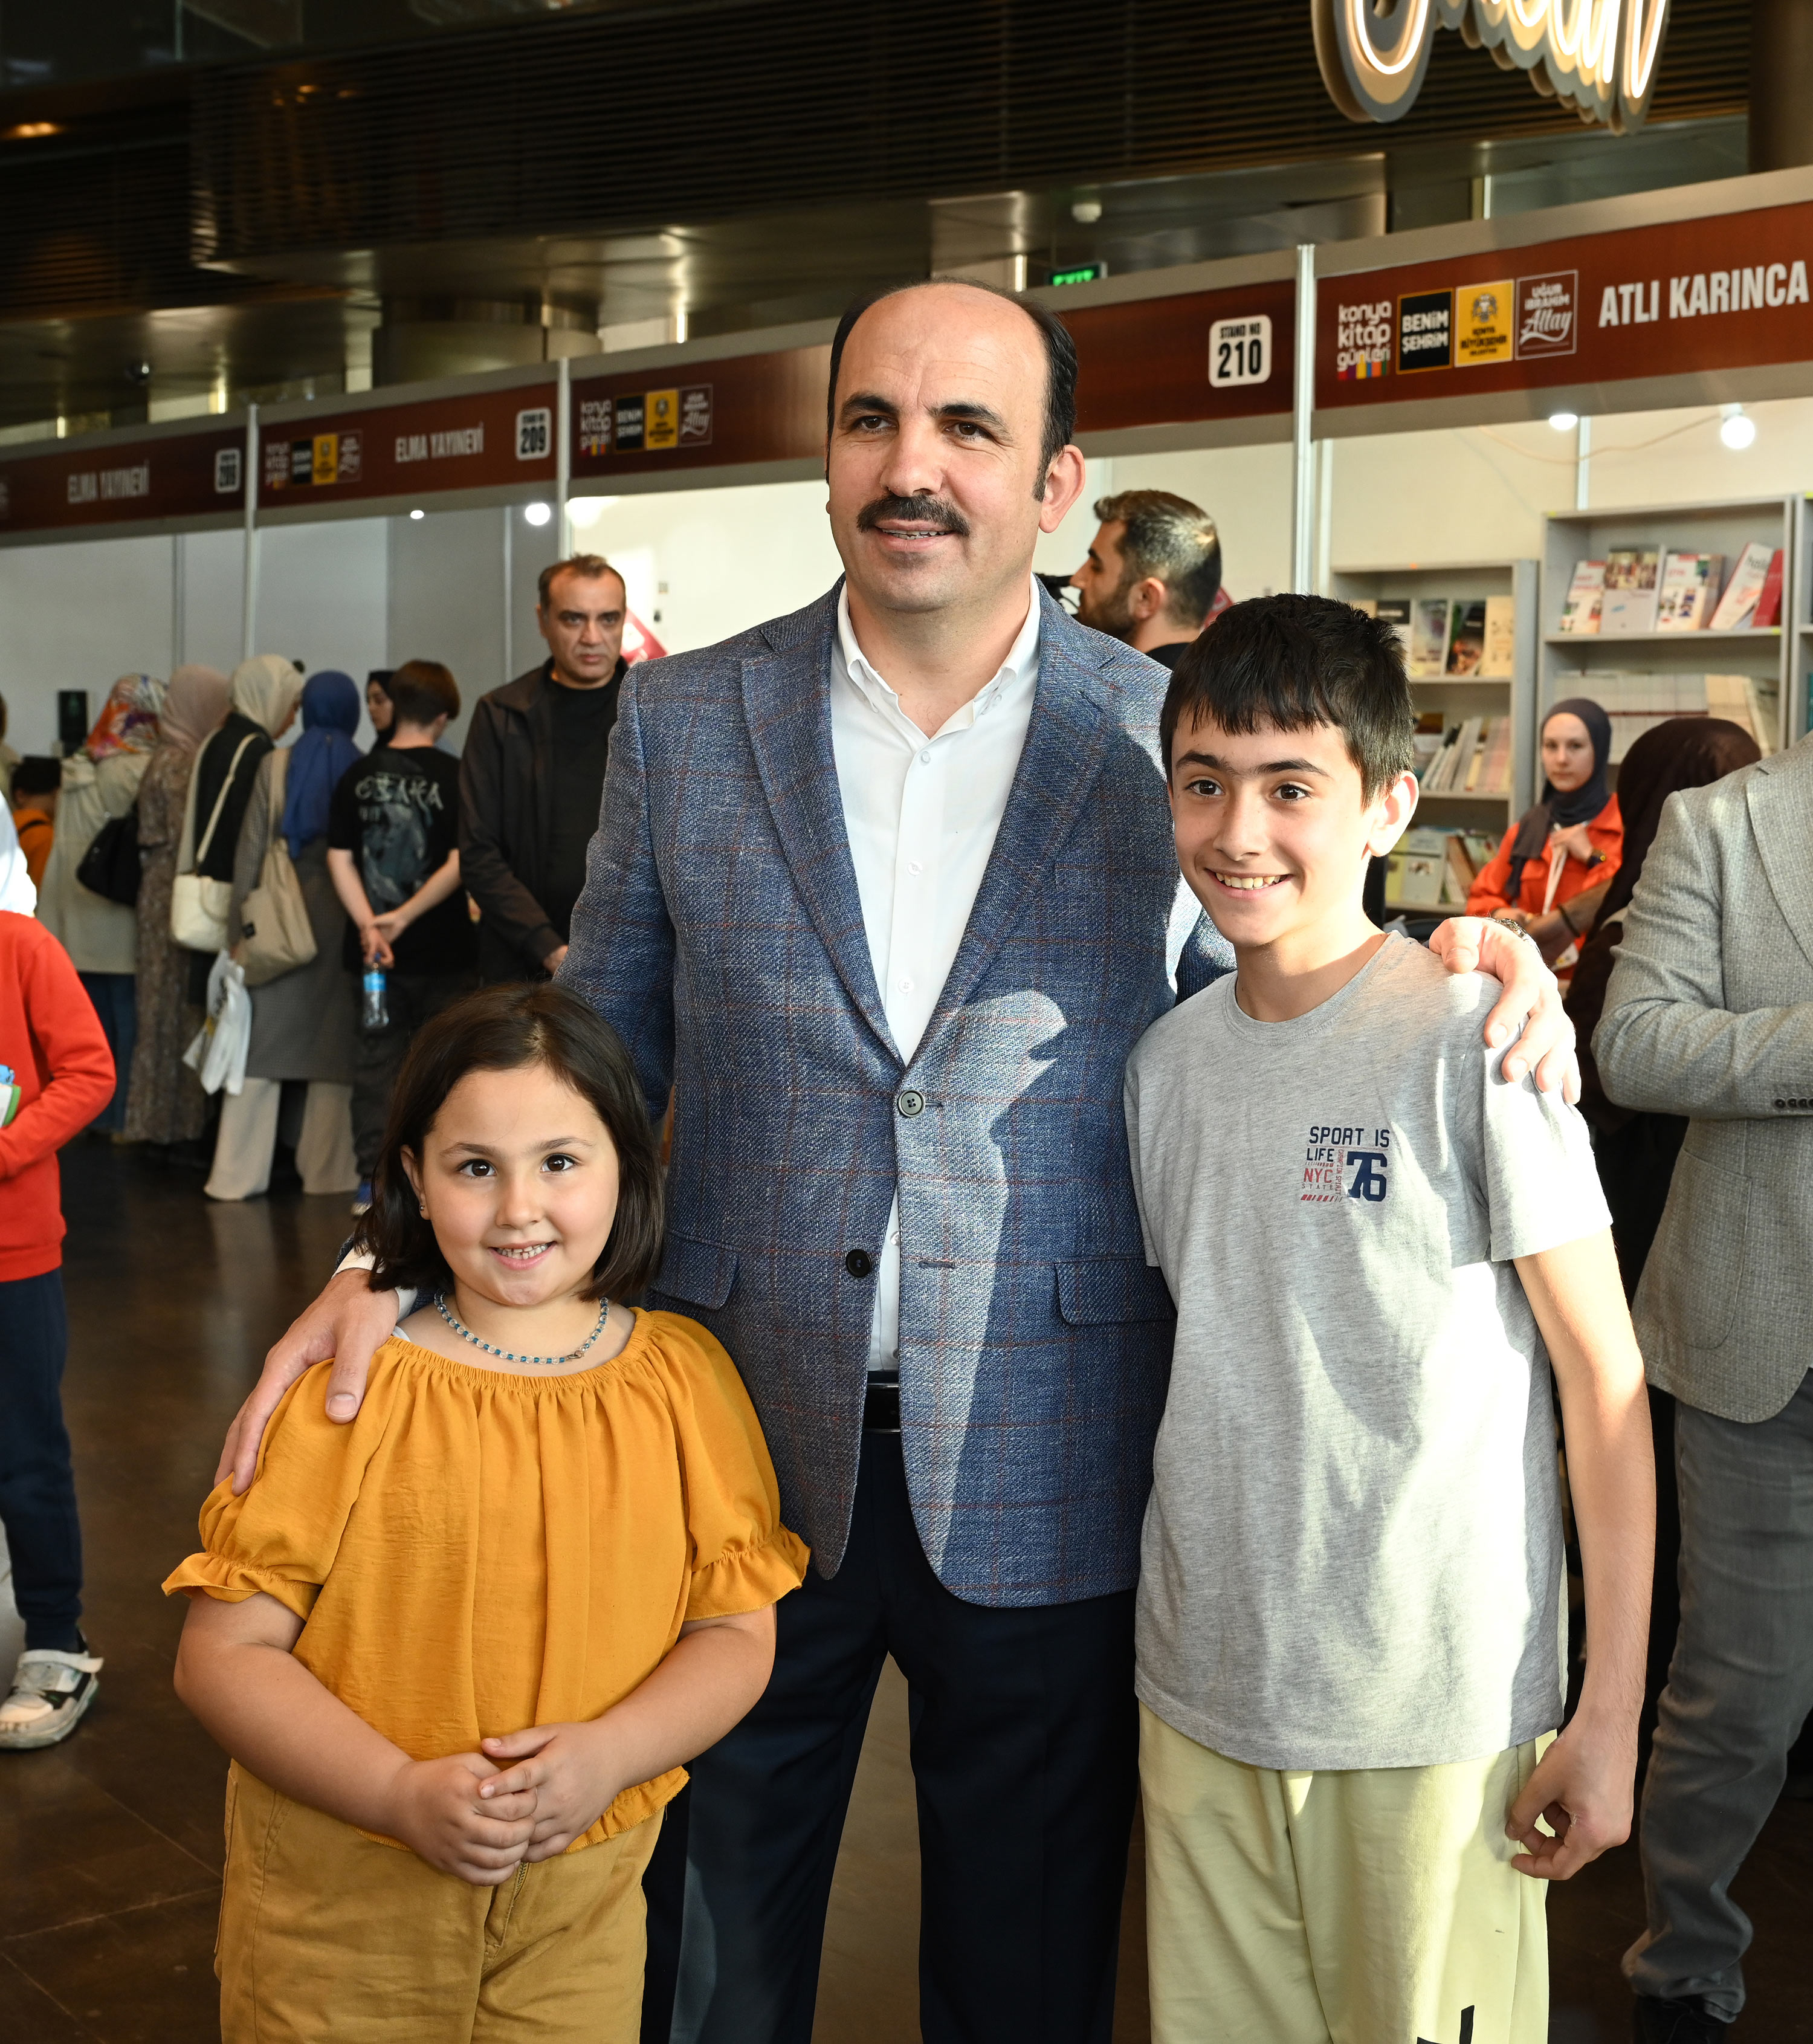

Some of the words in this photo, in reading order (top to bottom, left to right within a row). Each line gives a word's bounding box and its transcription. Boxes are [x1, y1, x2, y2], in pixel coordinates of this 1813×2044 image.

[1598, 280, 1659, 328] ATLI
[1669, 260, 1809, 319] KARINCA
[1339, 300, 1392, 325] konya
[1338, 323, 1391, 348] kitap
[1218, 338, 1261, 378] 210
[395, 433, 428, 463] ELMA
[521, 425, 546, 454] 209
[1309, 1127, 1364, 1145] SPORT
[1375, 1129, 1390, 1147] IS
[1307, 1148, 1334, 1162] LIFE
[1304, 1168, 1333, 1183] NYC
[1346, 1151, 1388, 1201] 76
